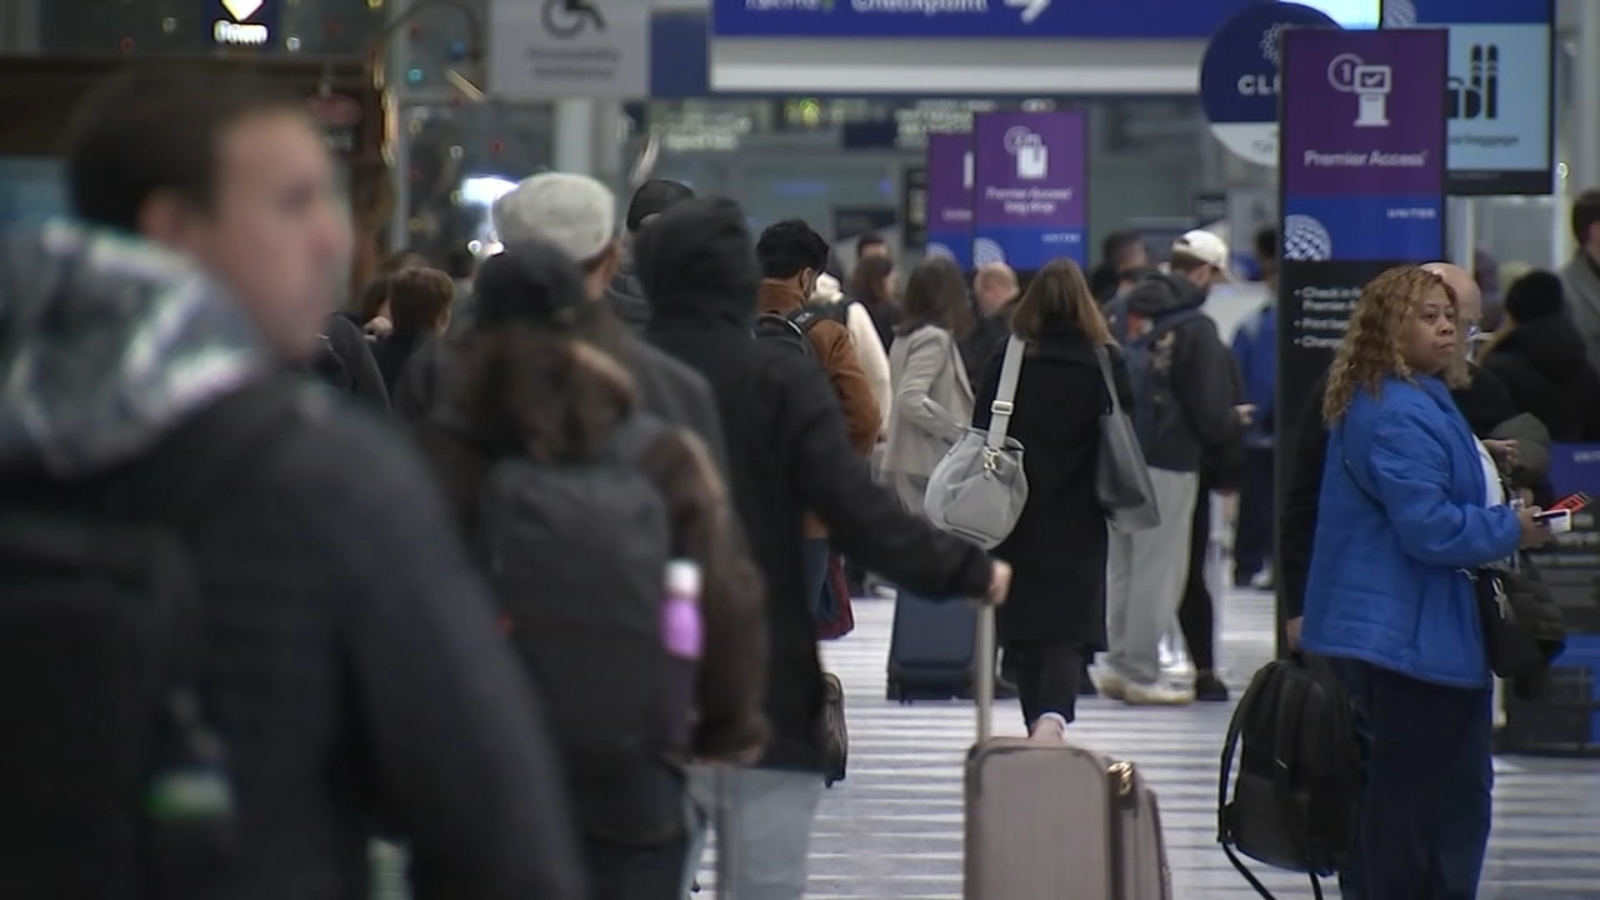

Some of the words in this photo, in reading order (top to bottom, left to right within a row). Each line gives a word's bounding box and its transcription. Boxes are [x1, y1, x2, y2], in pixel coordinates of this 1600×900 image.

[1304, 150, 1367, 166] Premier
[1368, 150, 1426, 167] Access
[1302, 286, 1338, 298] Check
